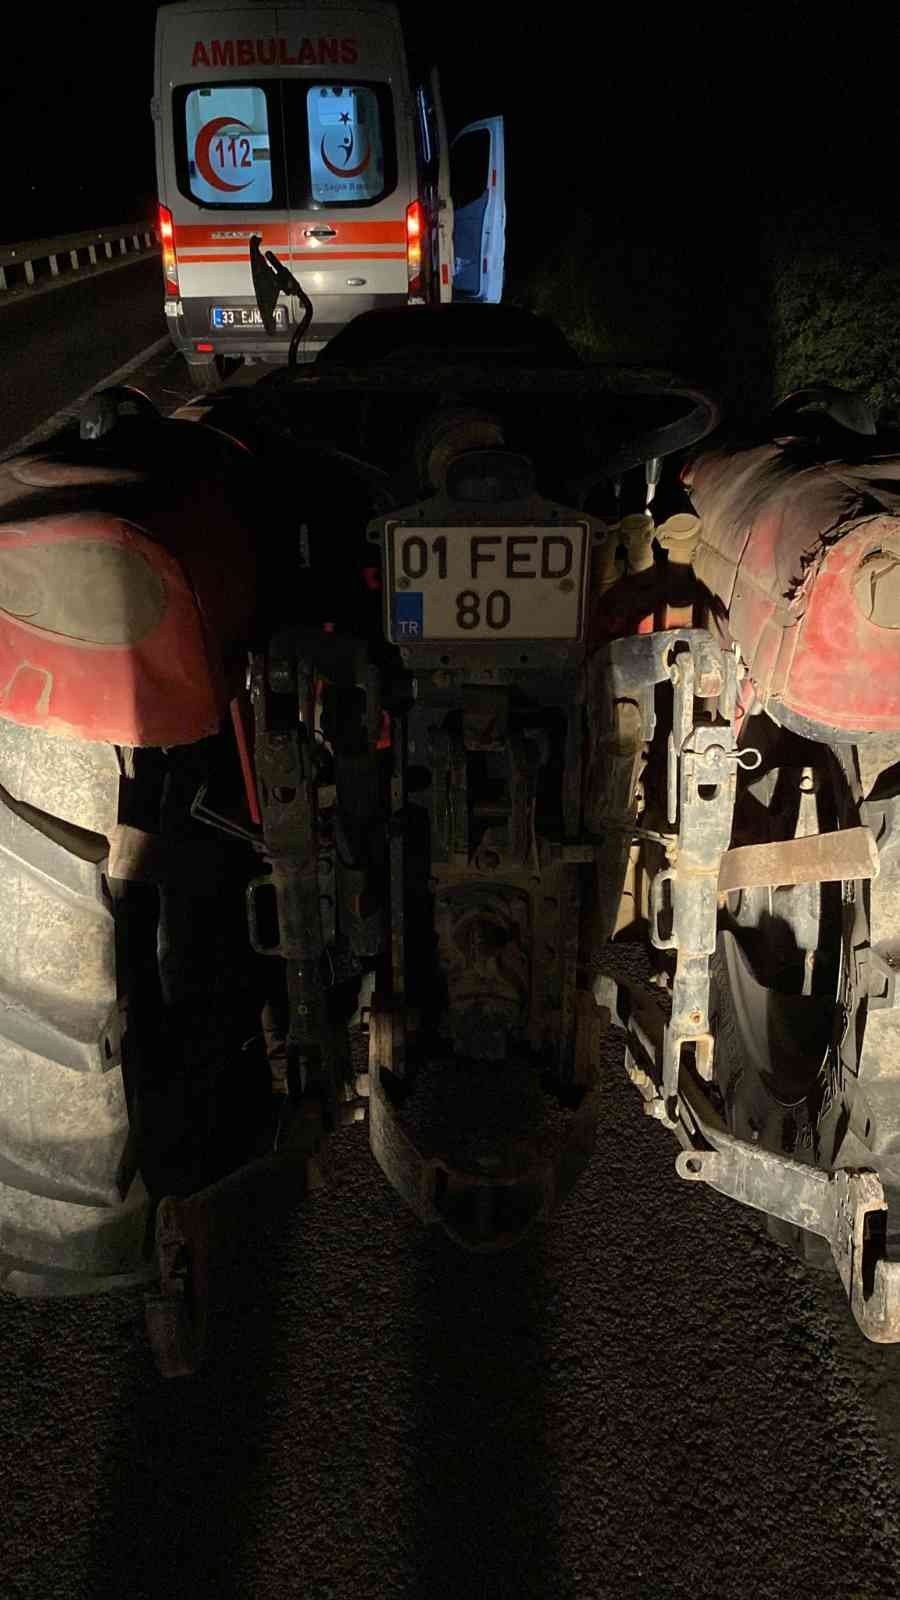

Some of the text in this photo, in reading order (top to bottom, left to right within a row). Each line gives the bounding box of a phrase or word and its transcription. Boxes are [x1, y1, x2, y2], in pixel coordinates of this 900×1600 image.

[192, 38, 359, 67] AMBULANS
[215, 139, 252, 169] 112
[222, 311, 234, 324] 33
[401, 535, 574, 579] 01 FED
[455, 589, 511, 631] 80
[399, 620, 419, 634] TR
